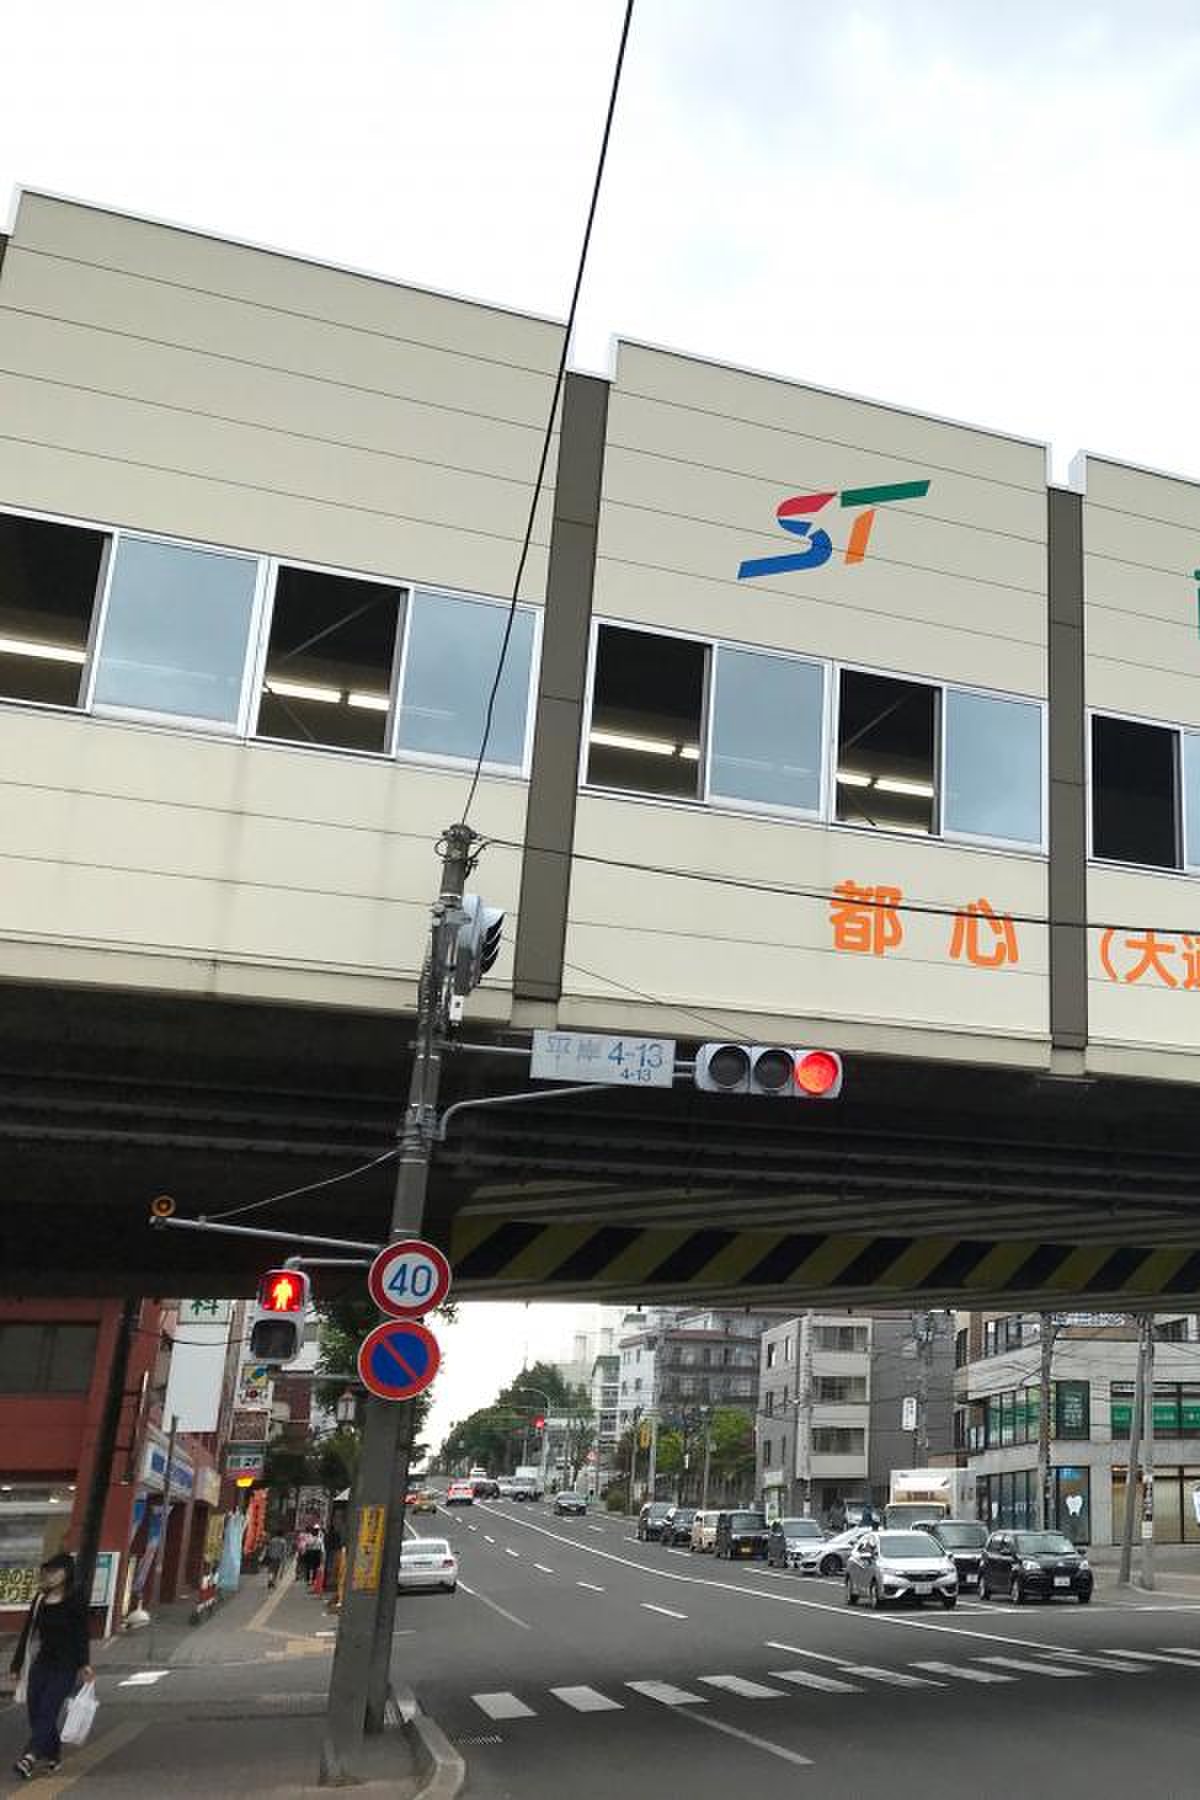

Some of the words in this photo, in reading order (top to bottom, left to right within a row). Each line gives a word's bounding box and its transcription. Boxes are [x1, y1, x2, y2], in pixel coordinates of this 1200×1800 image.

[607, 1041, 664, 1068] 4-13
[620, 1069, 652, 1082] 4-13
[388, 1263, 432, 1297] 40
